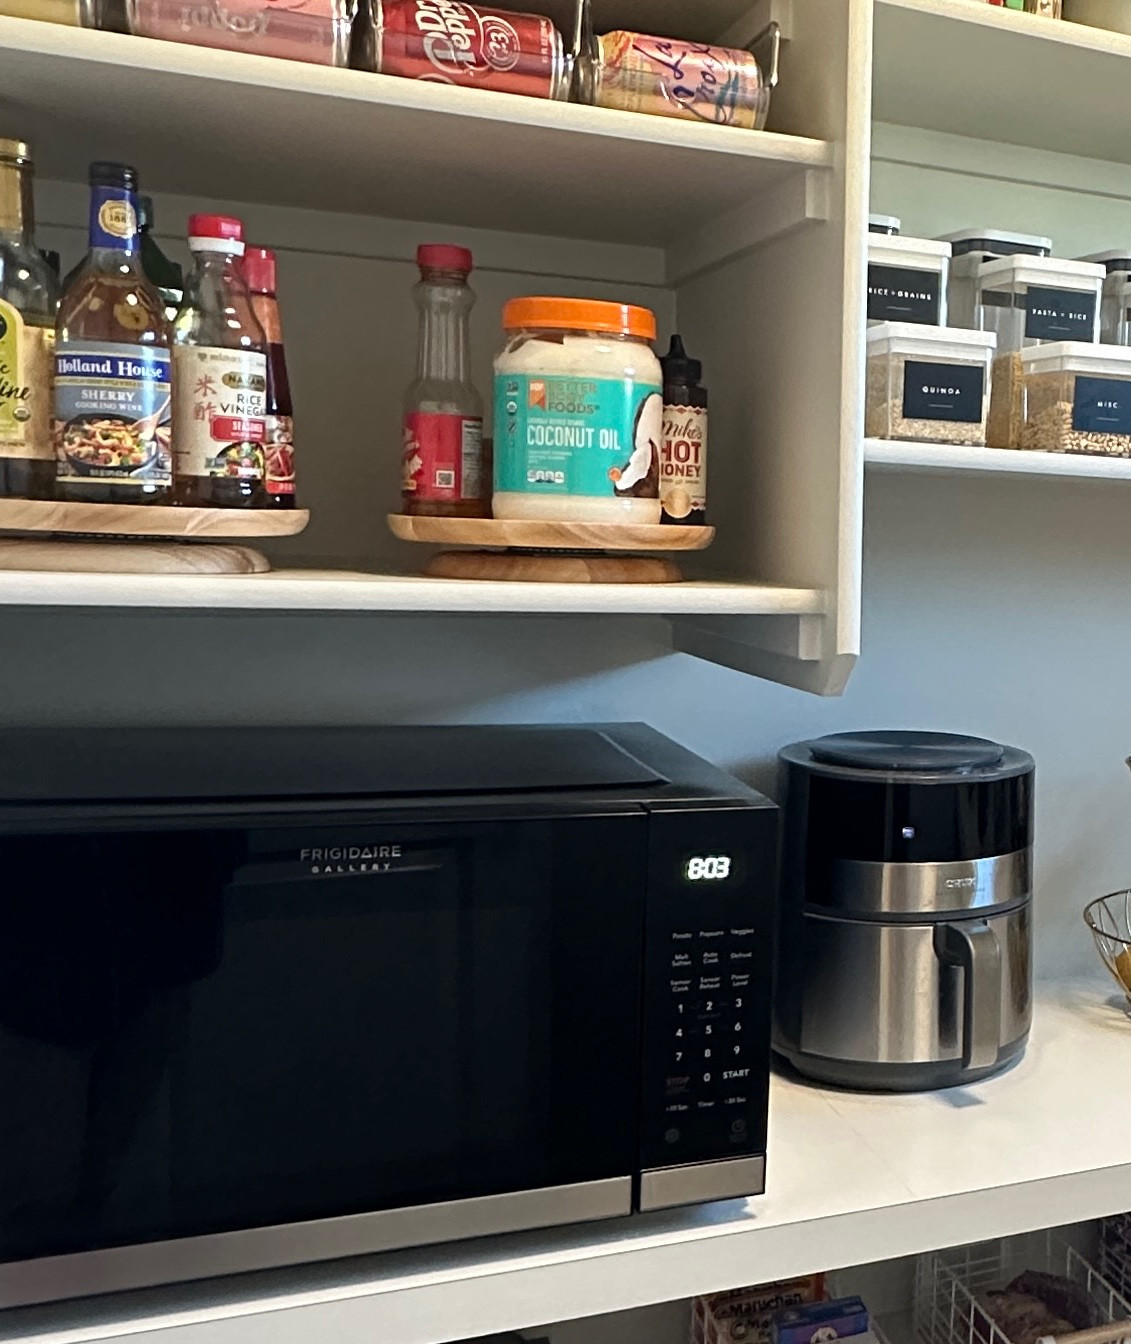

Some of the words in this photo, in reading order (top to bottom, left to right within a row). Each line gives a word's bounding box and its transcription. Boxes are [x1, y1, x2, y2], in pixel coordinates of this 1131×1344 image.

[415, 0, 448, 33] Dr
[868, 287, 888, 296] RICE
[897, 289, 932, 301] GRAINS
[1032, 308, 1057, 318] PASTA
[58, 358, 112, 374] Holland
[117, 360, 163, 378] House
[0, 378, 31, 401] ine
[922, 385, 961, 396] QUINOA
[81, 389, 136, 402] SHERRY
[237, 393, 262, 407] RICE
[75, 401, 117, 410] COOKING
[118, 402, 143, 412] WINE
[548, 402, 595, 414] FOODS
[1097, 400, 1118, 409] MISC
[527, 424, 595, 448] COCONUT
[599, 429, 621, 451] OIL
[300, 845, 402, 861] FRIGIDAIRE
[311, 862, 392, 874] GALLERY
[688, 856, 731, 880] 8:03
[706, 1000, 713, 1011] 2
[735, 997, 742, 1008] 3
[678, 1003, 684, 1014] 1
[705, 1024, 712, 1035] 5
[734, 1021, 742, 1032] 6
[675, 1028, 683, 1037] 4
[704, 1048, 711, 1058] 8
[733, 1044, 740, 1055] 9
[676, 1051, 683, 1062] 7
[703, 1072, 711, 1082] 0
[722, 1068, 750, 1080] START
